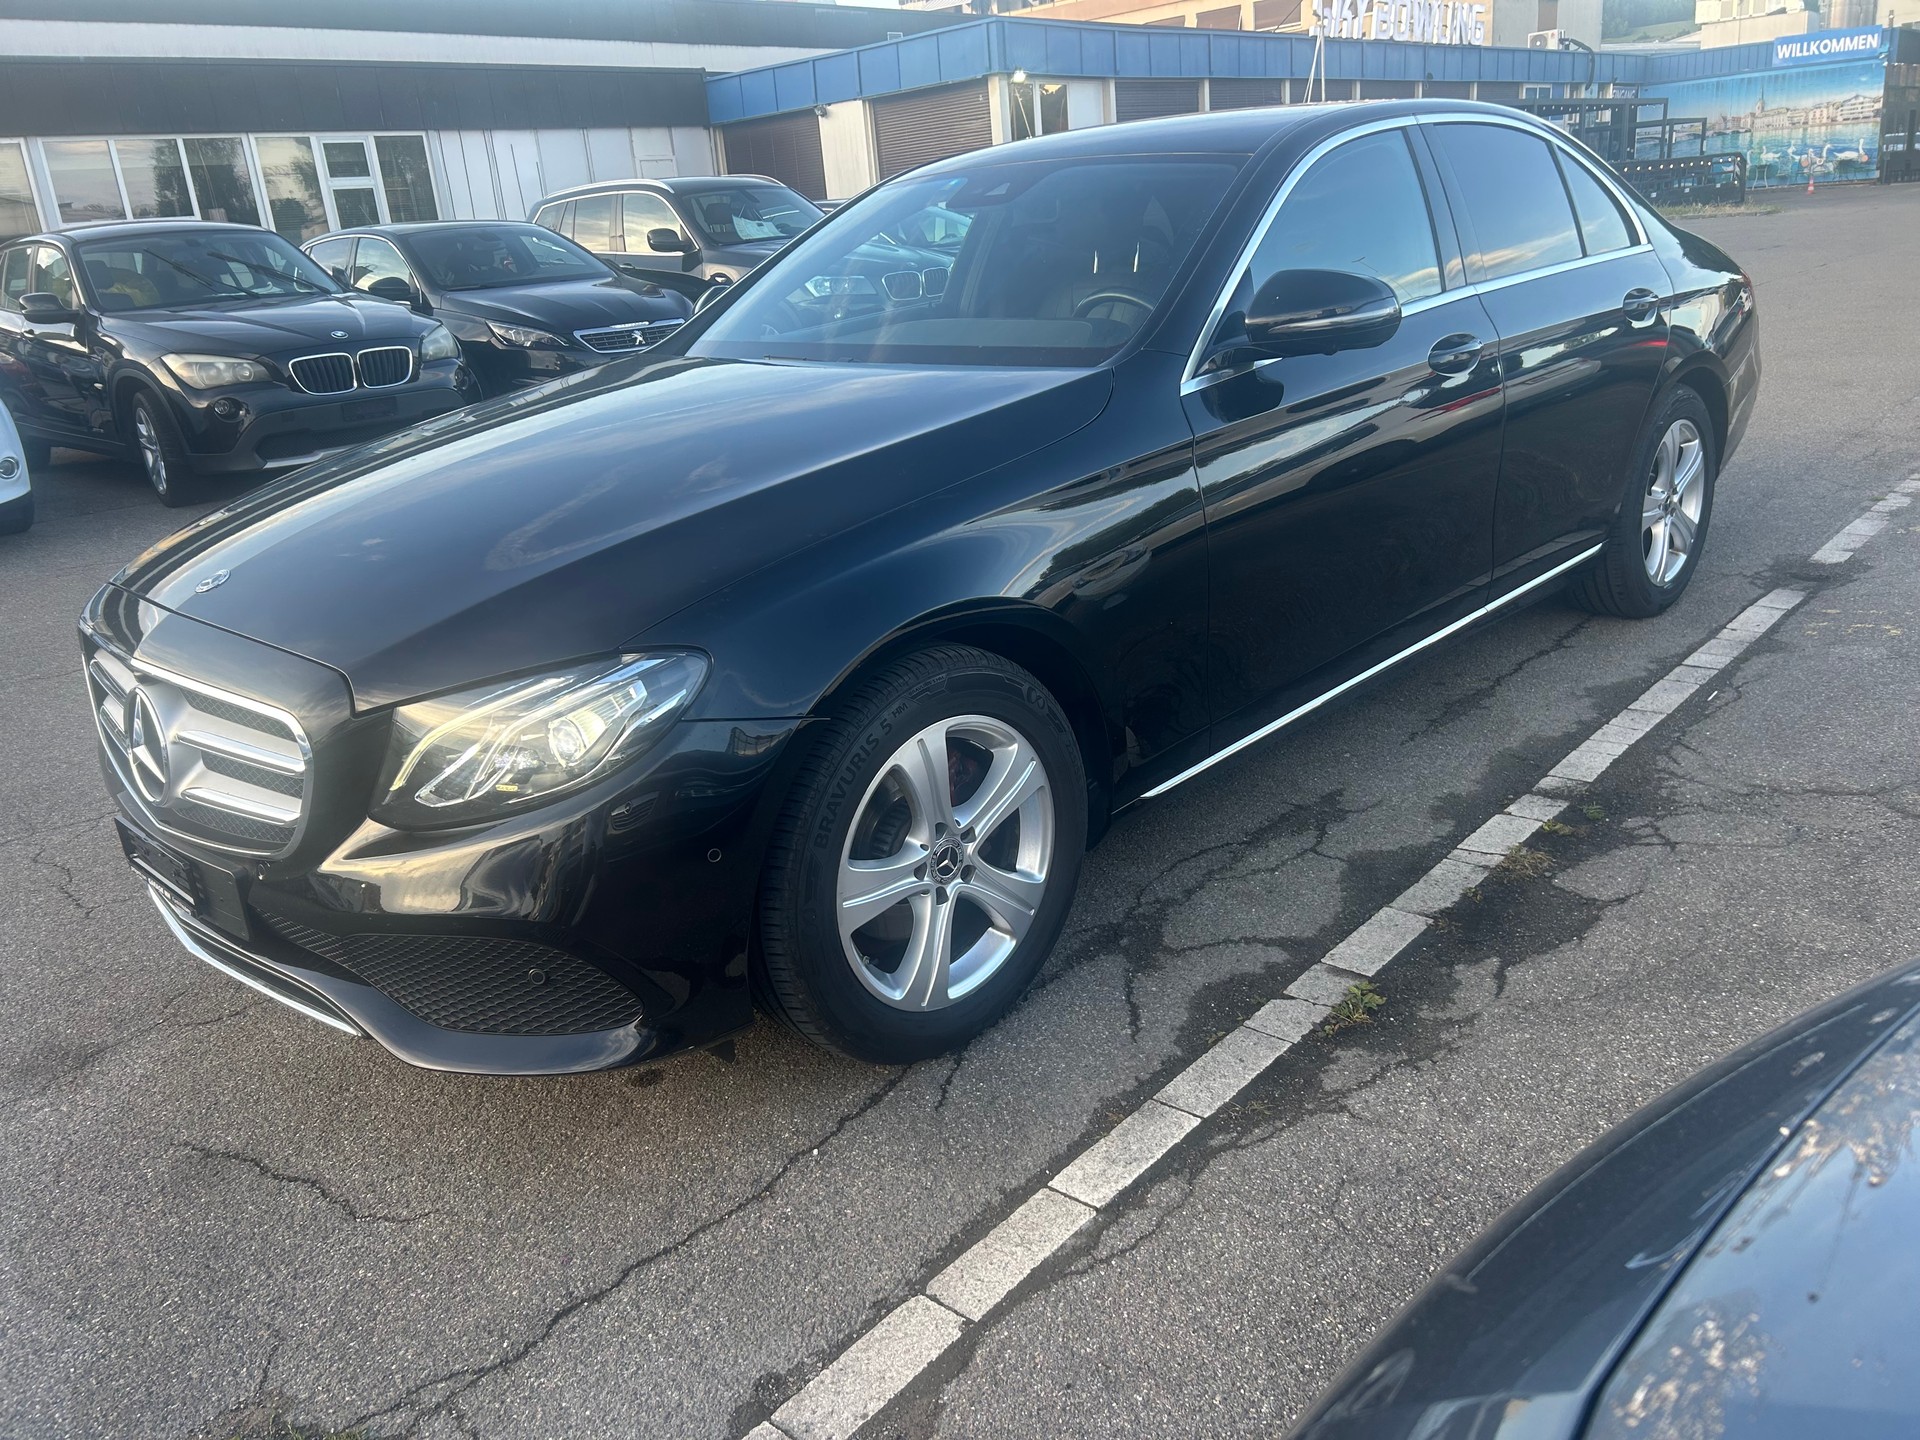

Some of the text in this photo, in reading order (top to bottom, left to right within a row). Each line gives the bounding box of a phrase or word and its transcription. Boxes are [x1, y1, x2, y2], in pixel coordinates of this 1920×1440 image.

[1308, 0, 1485, 46] SKY BOWLING
[1777, 33, 1879, 59] WILLKOMMEN
[813, 702, 909, 849] BRAVURIS 5 HM
